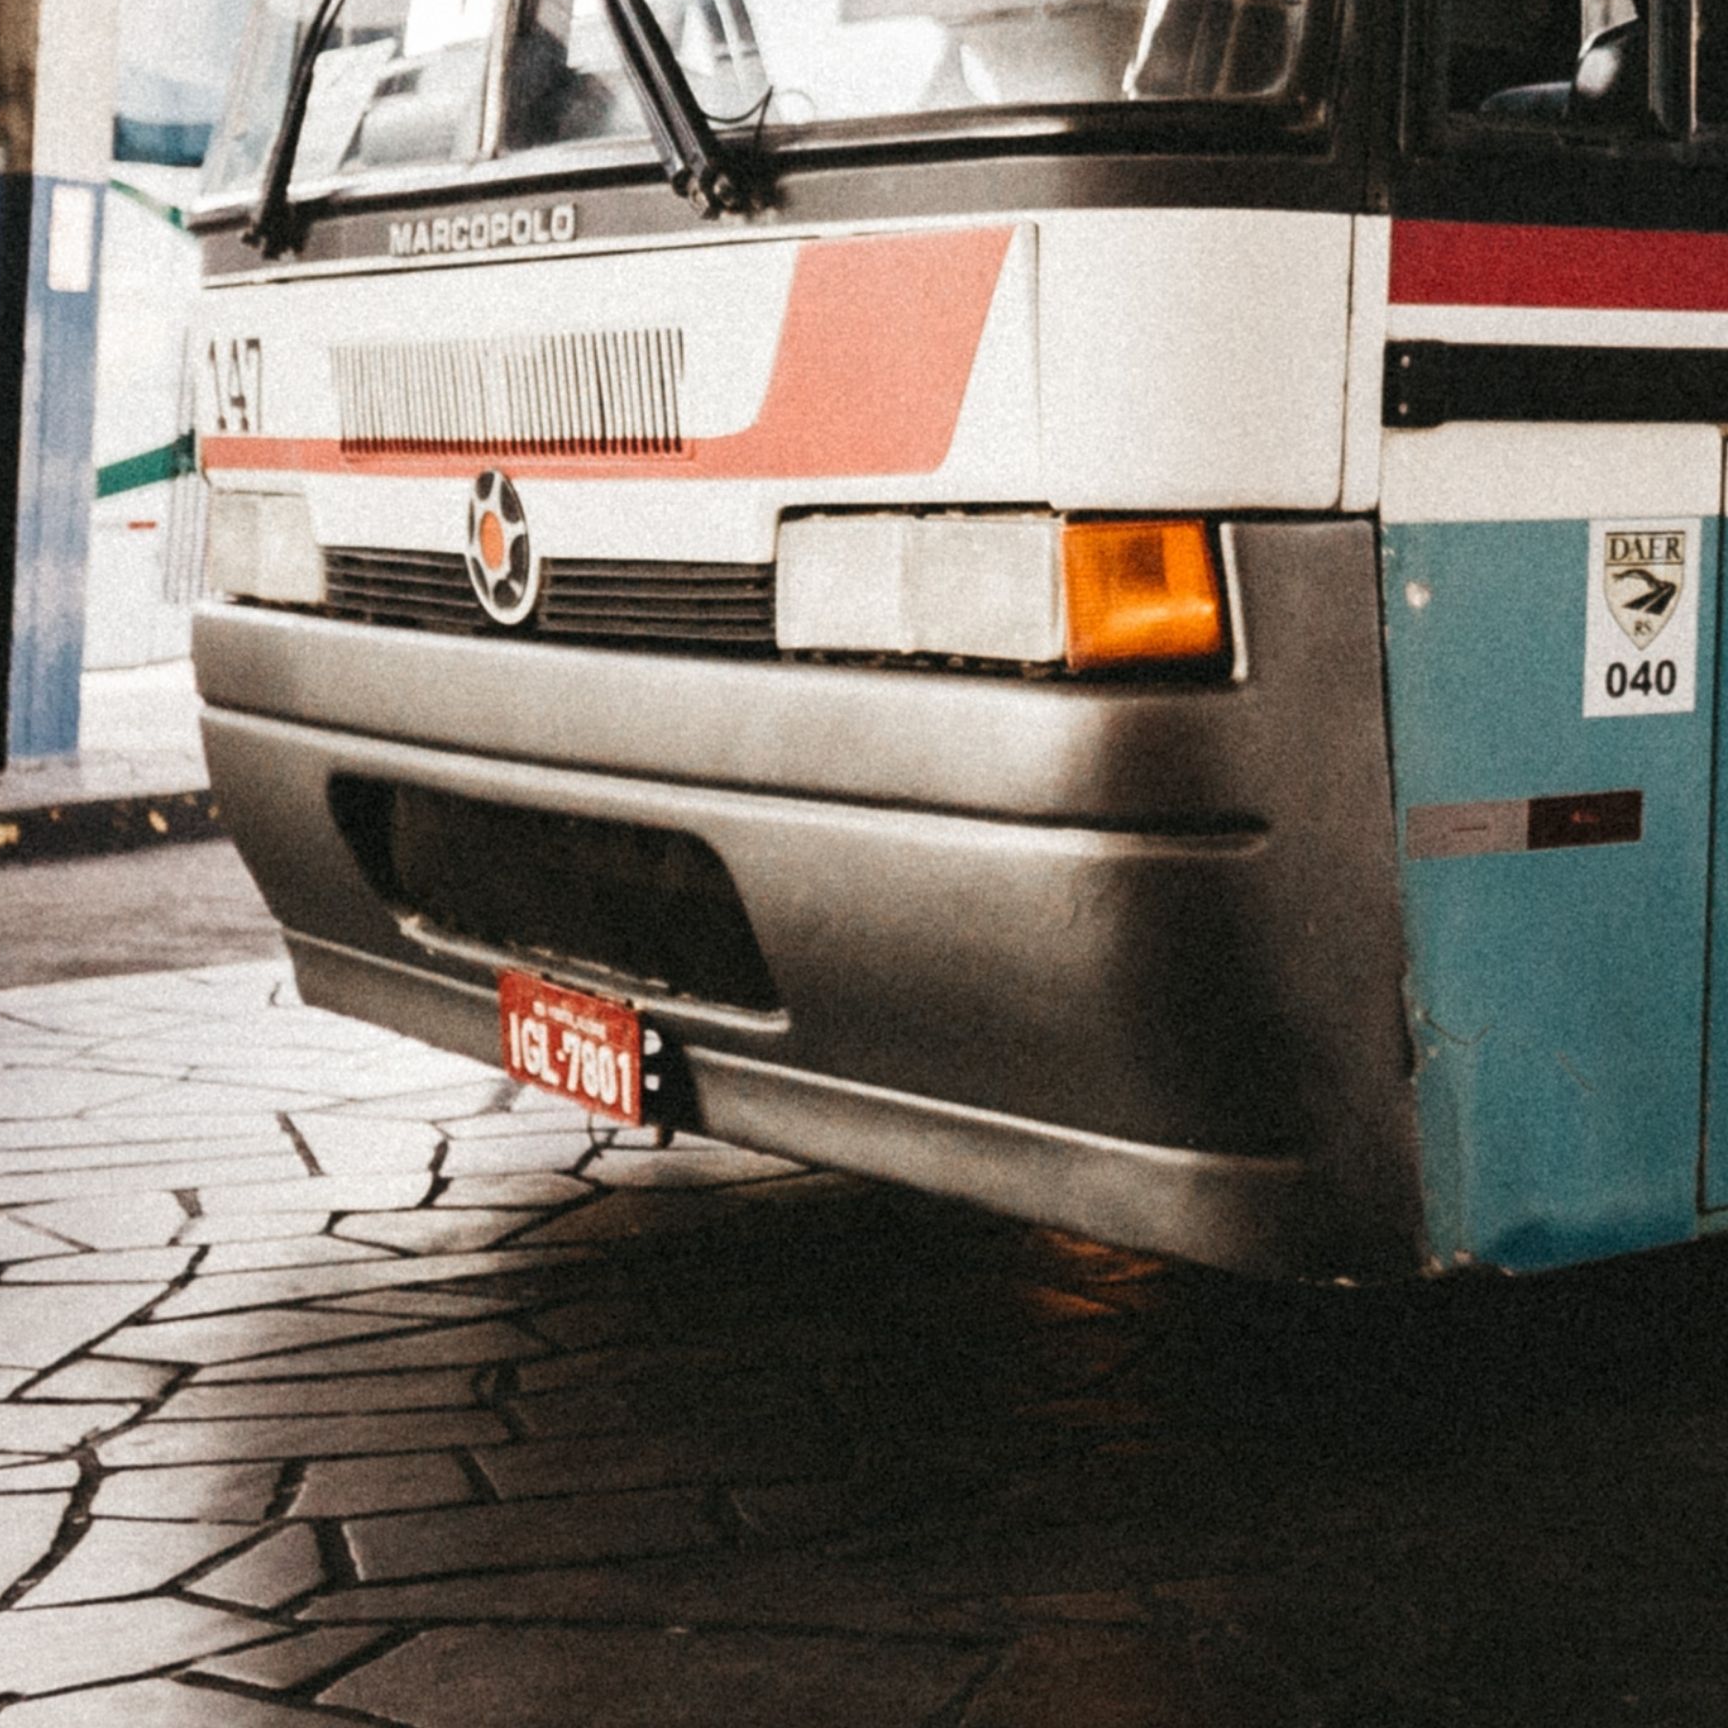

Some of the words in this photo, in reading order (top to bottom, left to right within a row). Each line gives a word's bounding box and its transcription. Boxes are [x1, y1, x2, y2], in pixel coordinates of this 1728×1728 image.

[389, 204, 576, 256] MARCOPOLO
[1609, 537, 1682, 561] DAER
[1605, 660, 1677, 698] 040
